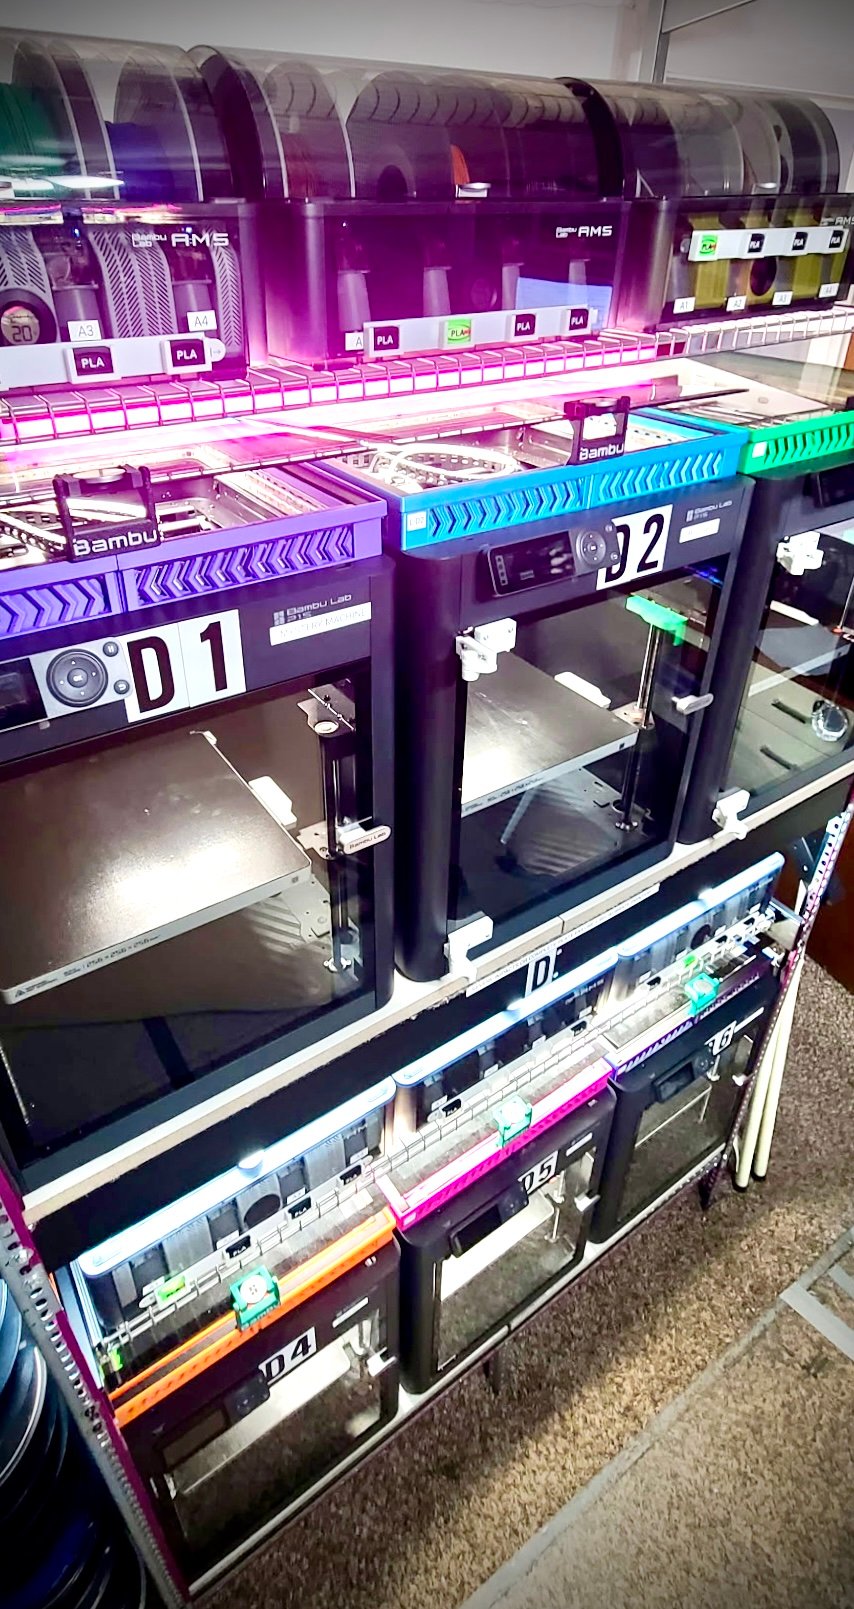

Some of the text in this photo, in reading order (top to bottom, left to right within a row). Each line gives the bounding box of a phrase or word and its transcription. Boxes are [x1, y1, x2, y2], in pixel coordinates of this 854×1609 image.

[578, 225, 613, 237] AMS
[171, 232, 229, 247] AMS
[750, 240, 760, 249] PLA
[793, 238, 804, 247] PLA
[680, 300, 688, 310] A1
[194, 315, 209, 327] A4
[516, 321, 531, 332] PLA
[571, 316, 584, 326] PLA
[11, 325, 33, 342] 20
[78, 324, 94, 337] A3
[376, 335, 394, 346] PLA
[176, 349, 198, 361] PLA
[81, 357, 105, 369] PLA
[579, 443, 624, 461] Bambu
[73, 529, 158, 556] Bambu
[286, 594, 352, 616] Bambu Lab
[265, 1334, 312, 1381] D4
